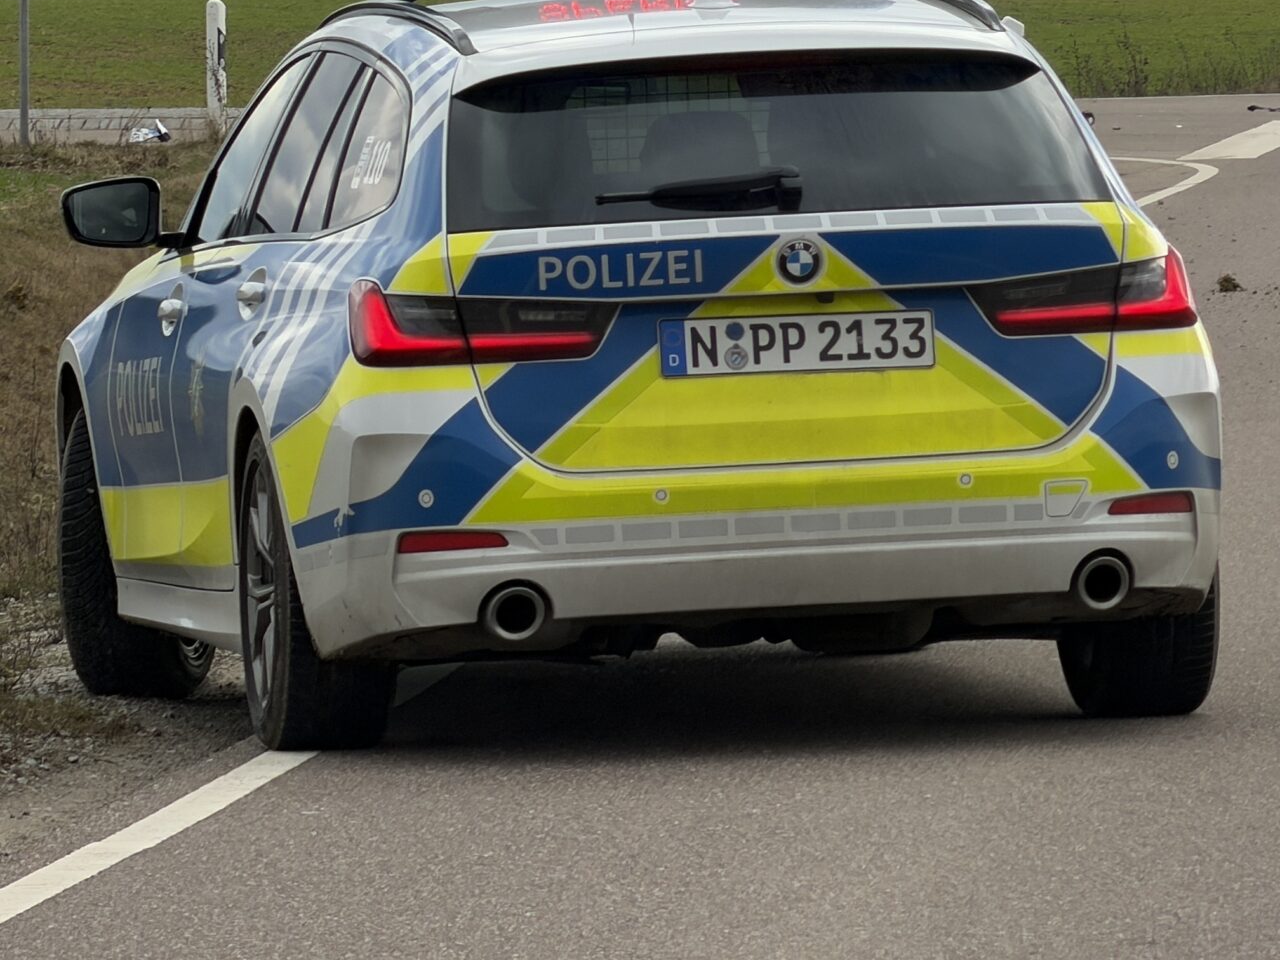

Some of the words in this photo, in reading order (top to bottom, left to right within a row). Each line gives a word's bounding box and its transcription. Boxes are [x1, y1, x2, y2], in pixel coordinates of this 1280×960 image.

[538, 249, 704, 291] POLIZEI
[669, 354, 680, 367] D
[689, 325, 719, 368] N
[750, 322, 806, 365] PP
[817, 317, 926, 362] 2133
[116, 356, 164, 436] POLIZEI
